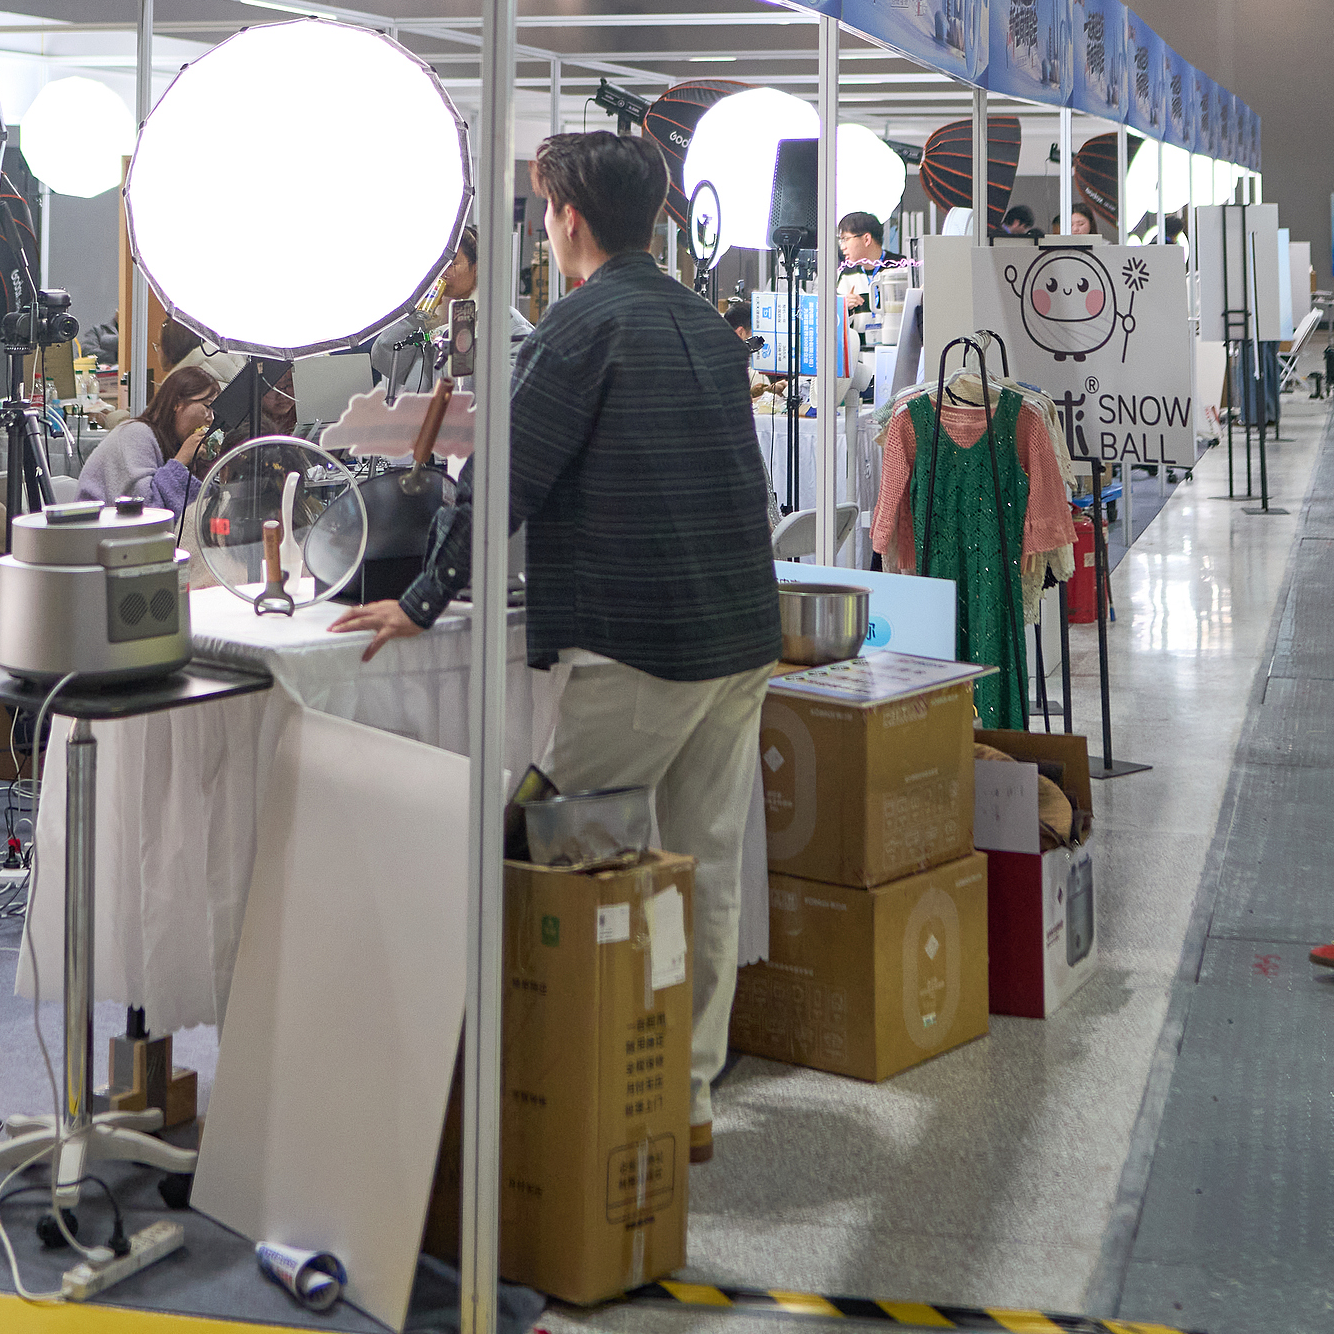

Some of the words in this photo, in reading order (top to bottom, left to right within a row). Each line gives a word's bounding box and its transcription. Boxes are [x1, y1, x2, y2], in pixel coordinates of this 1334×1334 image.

[669, 130, 692, 149] God
[1098, 394, 1191, 428] SNOW
[1100, 432, 1177, 465] BALL
